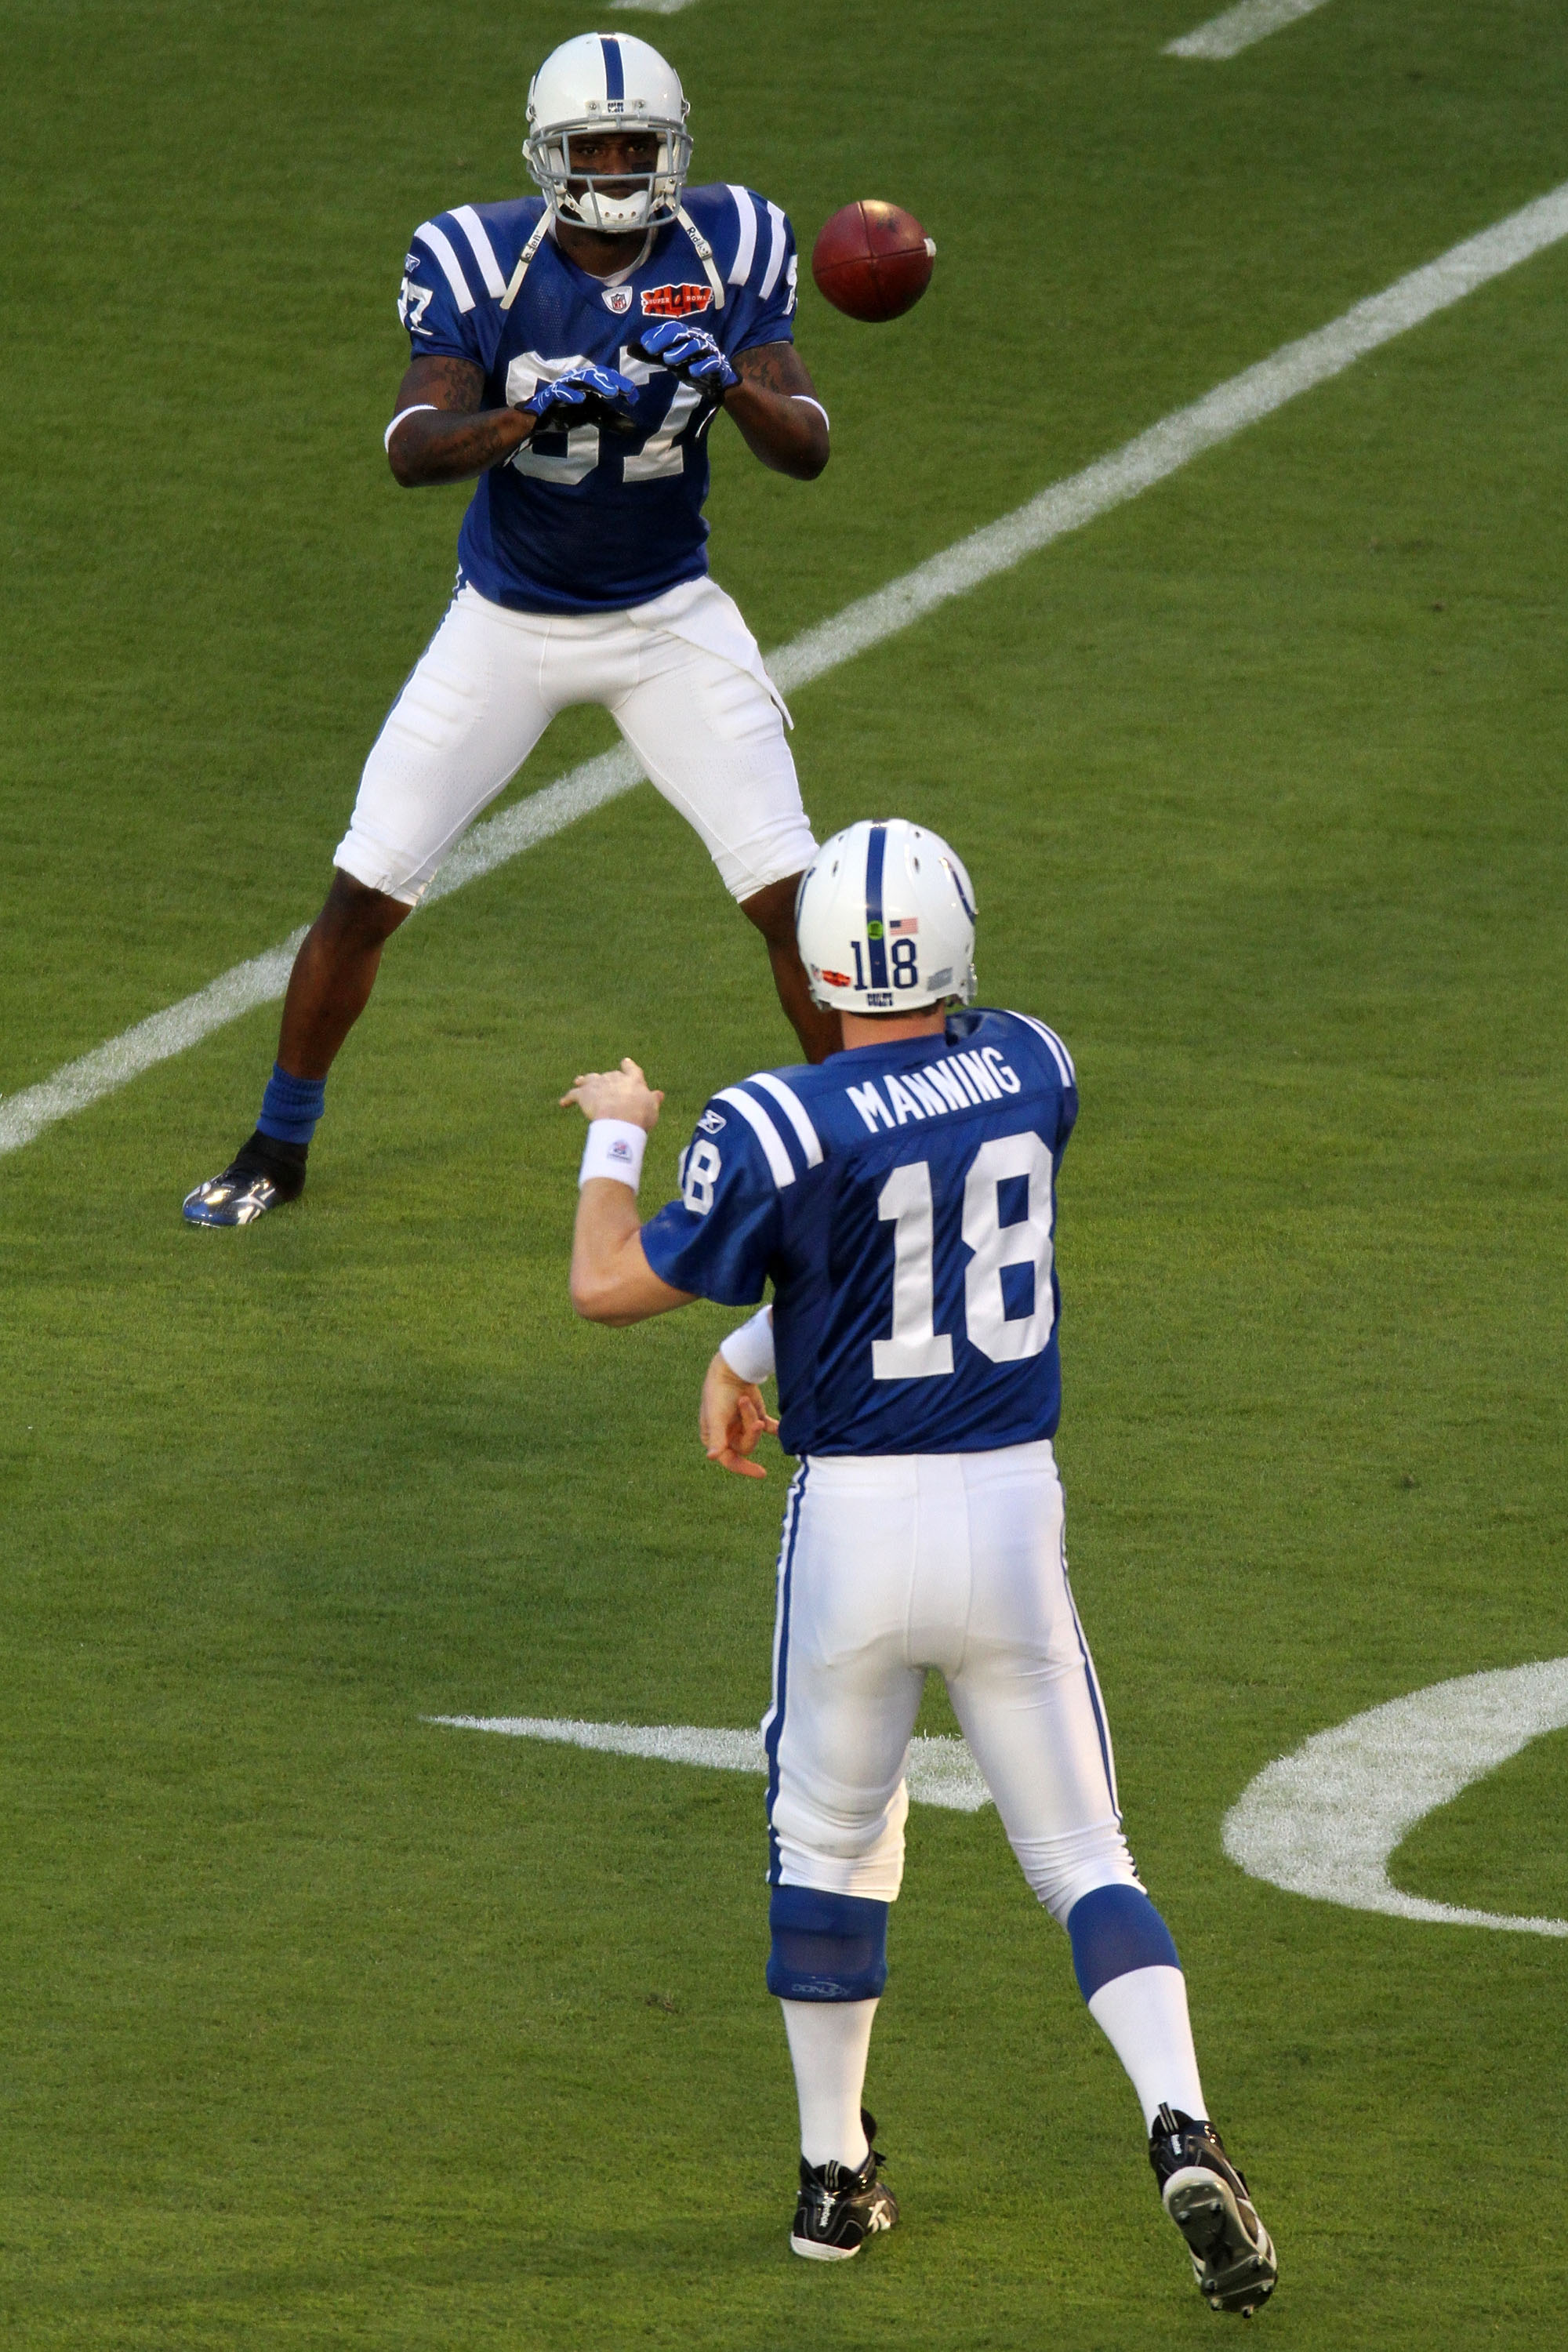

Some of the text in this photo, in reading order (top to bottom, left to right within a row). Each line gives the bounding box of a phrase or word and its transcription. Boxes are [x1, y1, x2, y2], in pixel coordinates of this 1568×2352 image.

[851, 938, 918, 990] 18
[845, 1047, 1021, 1133] MANNING
[872, 1131, 1054, 1380] 18
